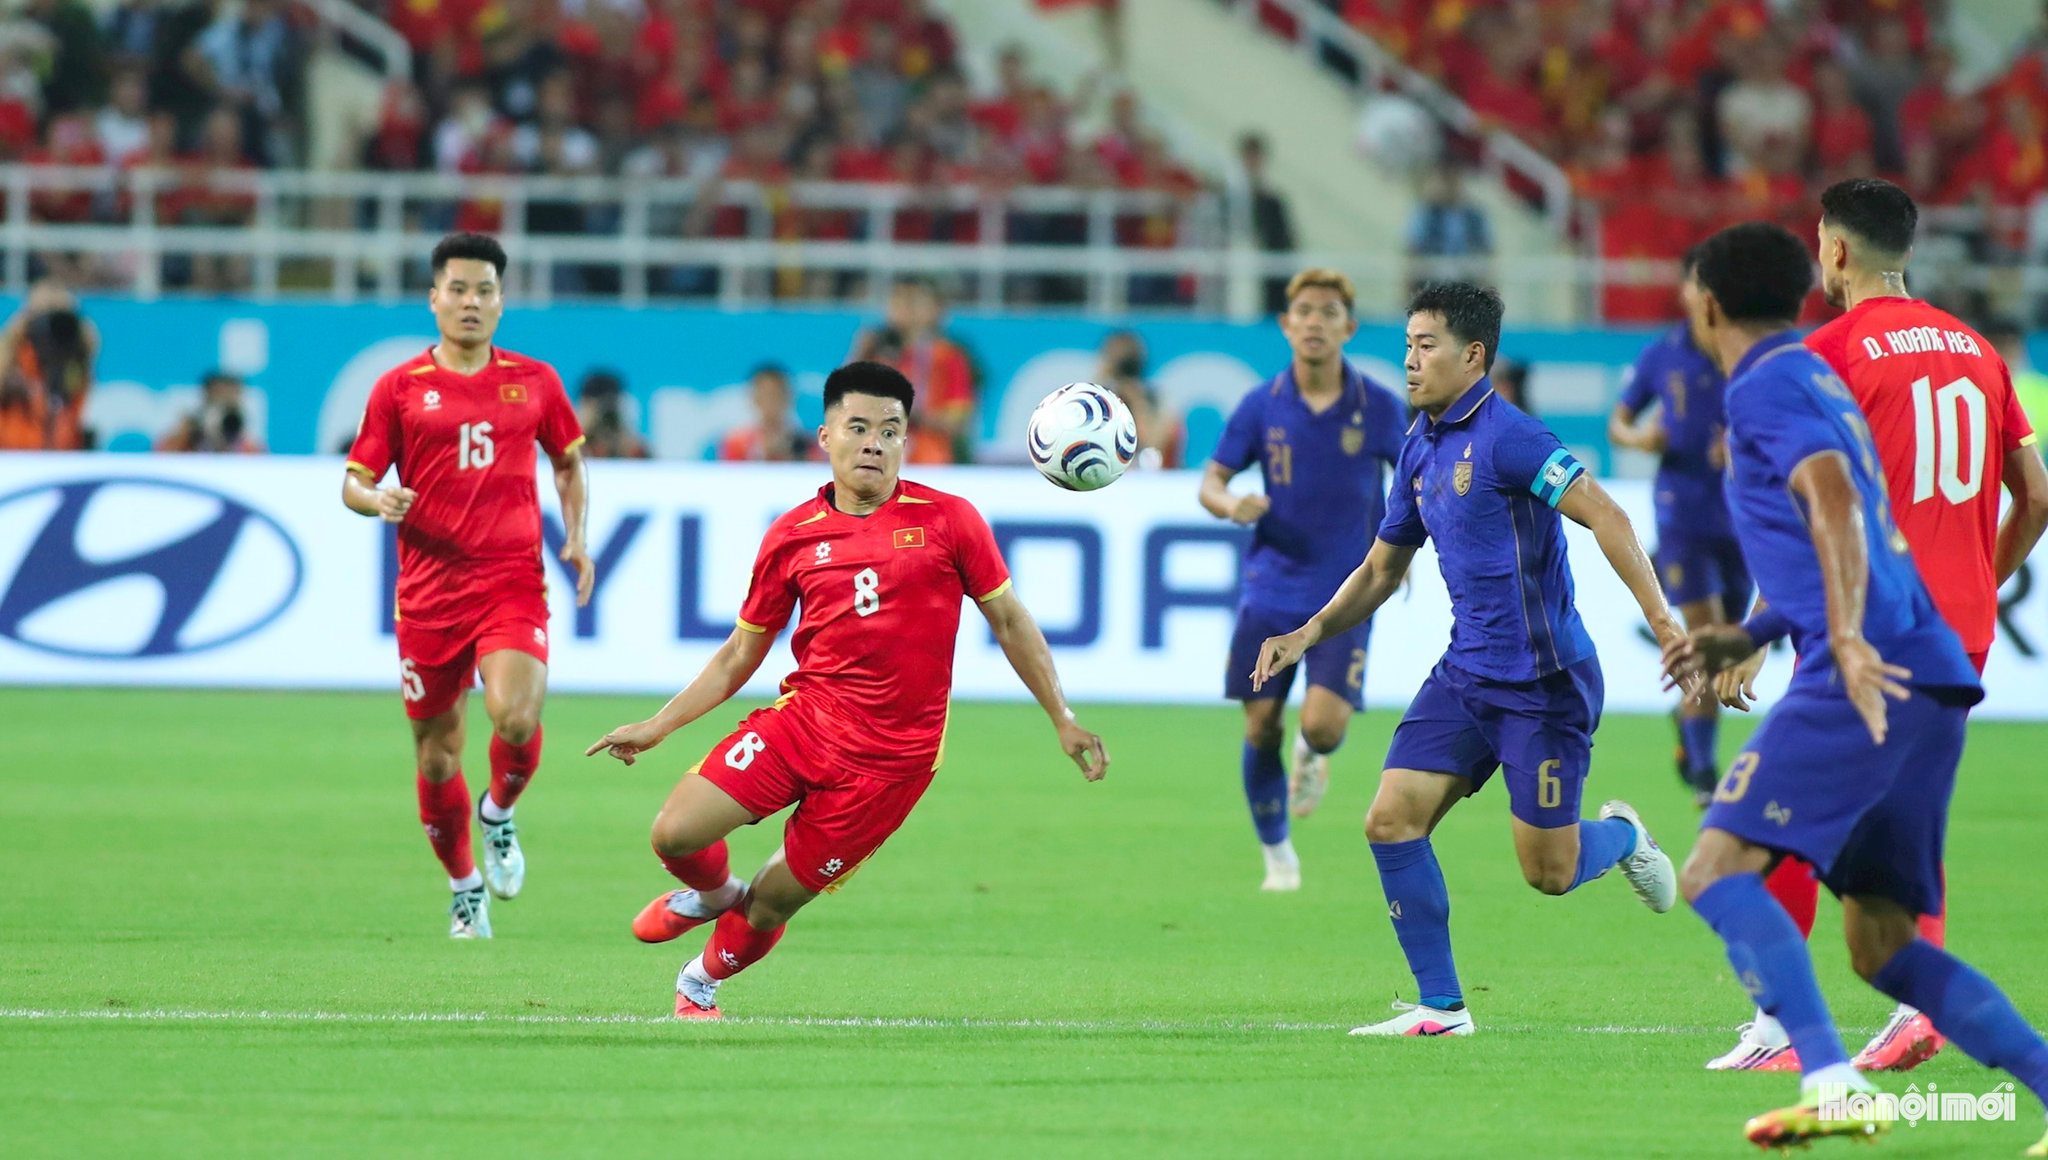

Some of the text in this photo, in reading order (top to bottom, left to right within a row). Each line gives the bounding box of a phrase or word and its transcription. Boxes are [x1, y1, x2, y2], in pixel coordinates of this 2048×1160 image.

[1862, 336, 1889, 360] D.
[1885, 326, 1945, 354] HOANG
[459, 421, 494, 470] 15
[1911, 375, 1986, 505] 10
[1266, 442, 1292, 485] 21
[854, 567, 879, 617] 8
[1346, 648, 1367, 689] 2
[724, 731, 766, 771] 8
[1538, 758, 1561, 808] 6
